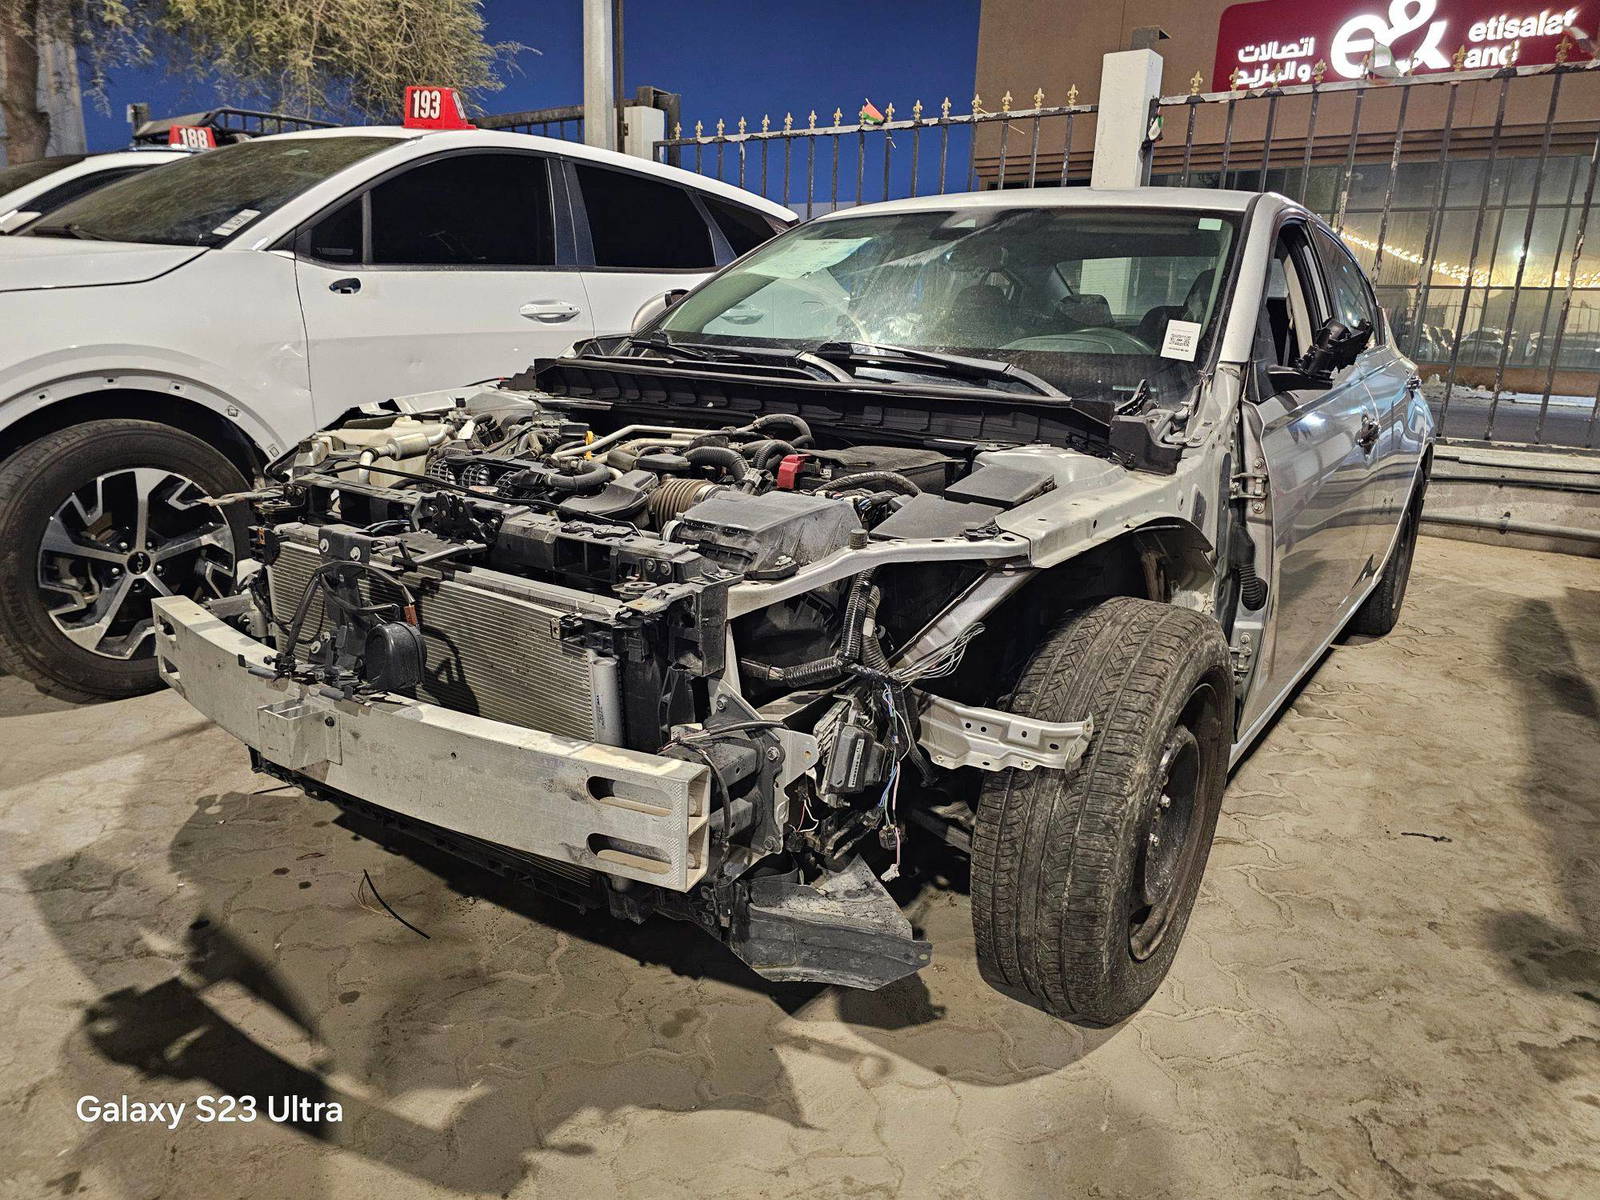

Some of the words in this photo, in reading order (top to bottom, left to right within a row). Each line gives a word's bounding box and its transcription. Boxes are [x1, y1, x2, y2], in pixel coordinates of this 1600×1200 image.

[1468, 6, 1580, 42] etisalat
[1238, 36, 1315, 63] اتصالات
[1330, 0, 1451, 79] e&
[1463, 39, 1519, 68] and
[413, 89, 441, 119] 193
[179, 127, 209, 149] 188
